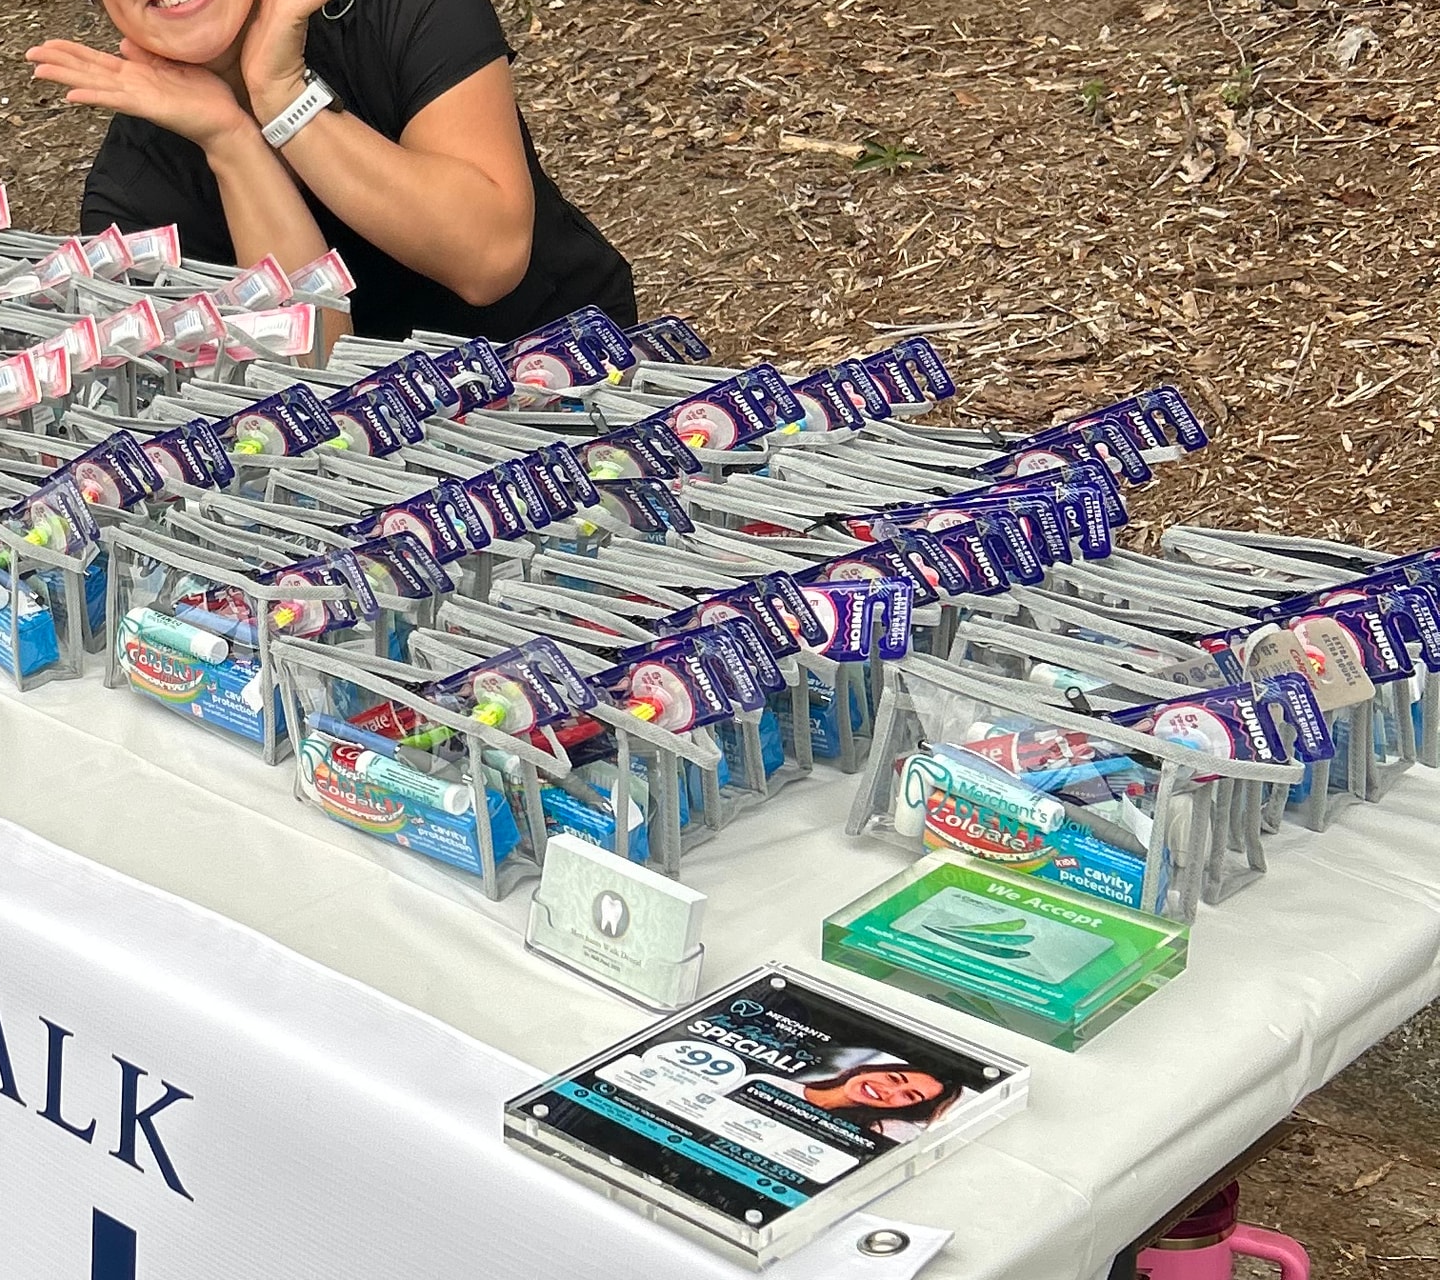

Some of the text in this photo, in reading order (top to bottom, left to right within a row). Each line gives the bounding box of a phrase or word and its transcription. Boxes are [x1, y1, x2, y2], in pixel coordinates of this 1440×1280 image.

[564, 340, 597, 377] JUNIOR
[643, 332, 675, 362] JUNIOR
[394, 373, 426, 412] JUNIOR
[823, 381, 853, 424] JUNIOR
[885, 361, 916, 403] JUNIOR
[276, 404, 308, 444] JUNIOR
[362, 405, 393, 447] JUNIOR
[731, 388, 764, 430] JUNIOR
[1129, 410, 1160, 448] JUNIO
[176, 438, 205, 481] JUNIOR
[631, 438, 668, 475] JUNIOR
[487, 483, 518, 530] JUNIOR
[535, 464, 567, 511] JUNIOR
[426, 503, 457, 551] JUNIOR
[967, 536, 999, 587] JUNIOR
[750, 595, 789, 645] JUNIOR
[850, 592, 865, 651] JUNIOR
[1365, 612, 1398, 670] JUNIOR
[516, 663, 559, 713] JUNIOR
[686, 656, 723, 711] JUNIOR
[1236, 698, 1272, 760] JUNIOR
[1288, 690, 1315, 749] EXTRA SOUPLE
[1300, 693, 1324, 741] EXTRA SOFT
[960, 781, 1048, 824] Merchant's
[418, 828, 473, 853] protection
[430, 824, 467, 845] cavity
[932, 807, 1027, 853] Colgate
[1060, 869, 1133, 904] protection
[1084, 866, 1134, 892] cavity
[984, 883, 1104, 928] We Accept
[687, 1020, 807, 1073] SPECIAL!
[765, 1010, 832, 1042] MERCHANTS
[775, 1022, 808, 1039] WALK
[675, 1045, 735, 1076] $99
[747, 1086, 774, 1101] EVEN
[774, 1098, 820, 1122] WITHOUT
[714, 1138, 806, 1185] 770.691.5051
